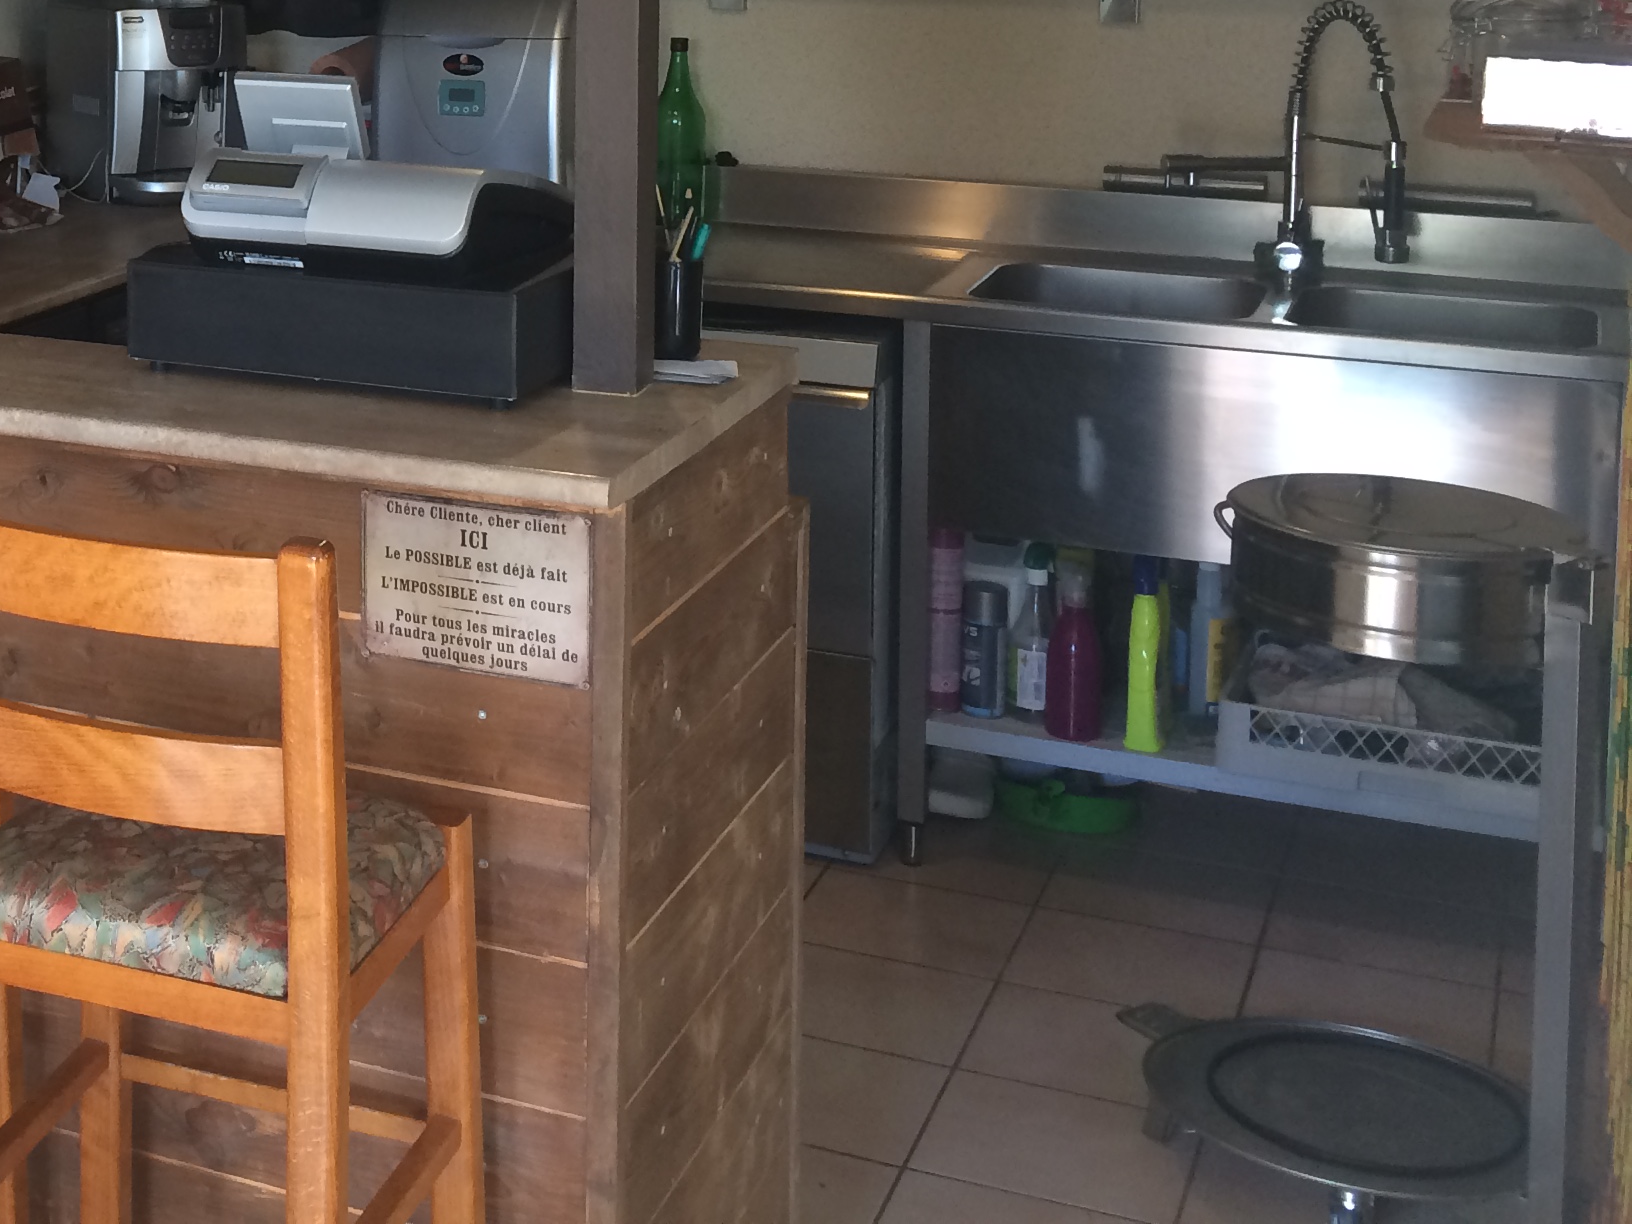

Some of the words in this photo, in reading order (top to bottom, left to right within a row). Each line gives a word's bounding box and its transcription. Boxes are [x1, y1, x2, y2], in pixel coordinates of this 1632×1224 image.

[202, 183, 230, 191] CASIO
[430, 506, 483, 526] Cliente,
[488, 514, 521, 529] cher
[524, 519, 567, 535] client
[460, 529, 489, 550] ICI
[385, 546, 401, 559] Le
[405, 549, 472, 570] POSSIBLE
[476, 561, 499, 574] est
[502, 562, 535, 580] déjà
[540, 567, 568, 583] fait
[381, 576, 478, 602] L'IMPOSSIBLE
[482, 592, 504, 606] est
[508, 596, 525, 609] en
[530, 599, 572, 615] cours
[375, 621, 384, 634] il
[389, 622, 436, 642] faudra
[440, 633, 493, 651] prévoir
[497, 641, 515, 654] un
[519, 644, 557, 660] délai
[561, 649, 579, 664] de
[395, 609, 428, 625] Pour
[432, 615, 462, 630] tous
[466, 619, 487, 634] les
[492, 624, 557, 644] miracles
[421, 645, 485, 665] quelques
[489, 654, 528, 672] jours
